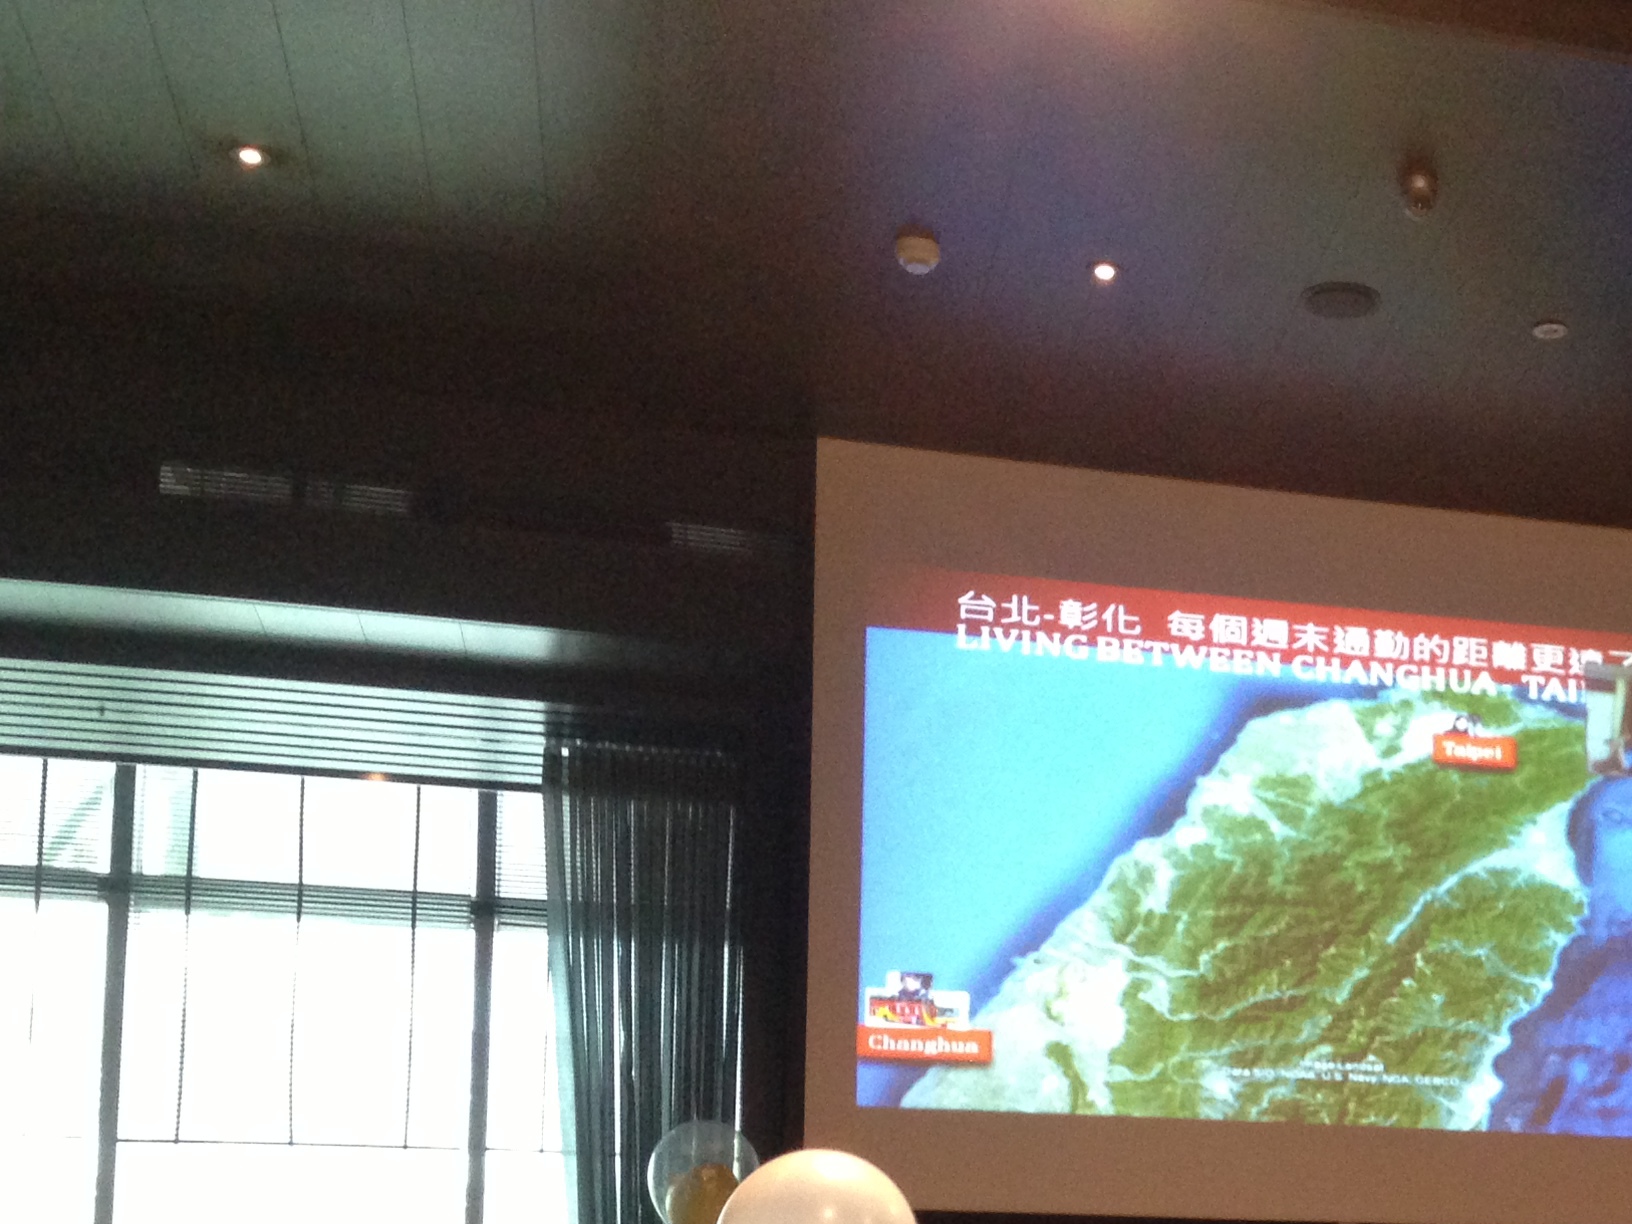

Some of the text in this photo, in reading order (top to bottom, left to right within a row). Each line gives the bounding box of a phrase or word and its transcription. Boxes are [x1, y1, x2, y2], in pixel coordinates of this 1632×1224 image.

[956, 623, 1090, 660] LIVING
[1096, 636, 1281, 677] BETWEEN
[1520, 674, 1586, 703] TAI
[1442, 740, 1502, 762] Taipei
[867, 1033, 980, 1056] Changhua
